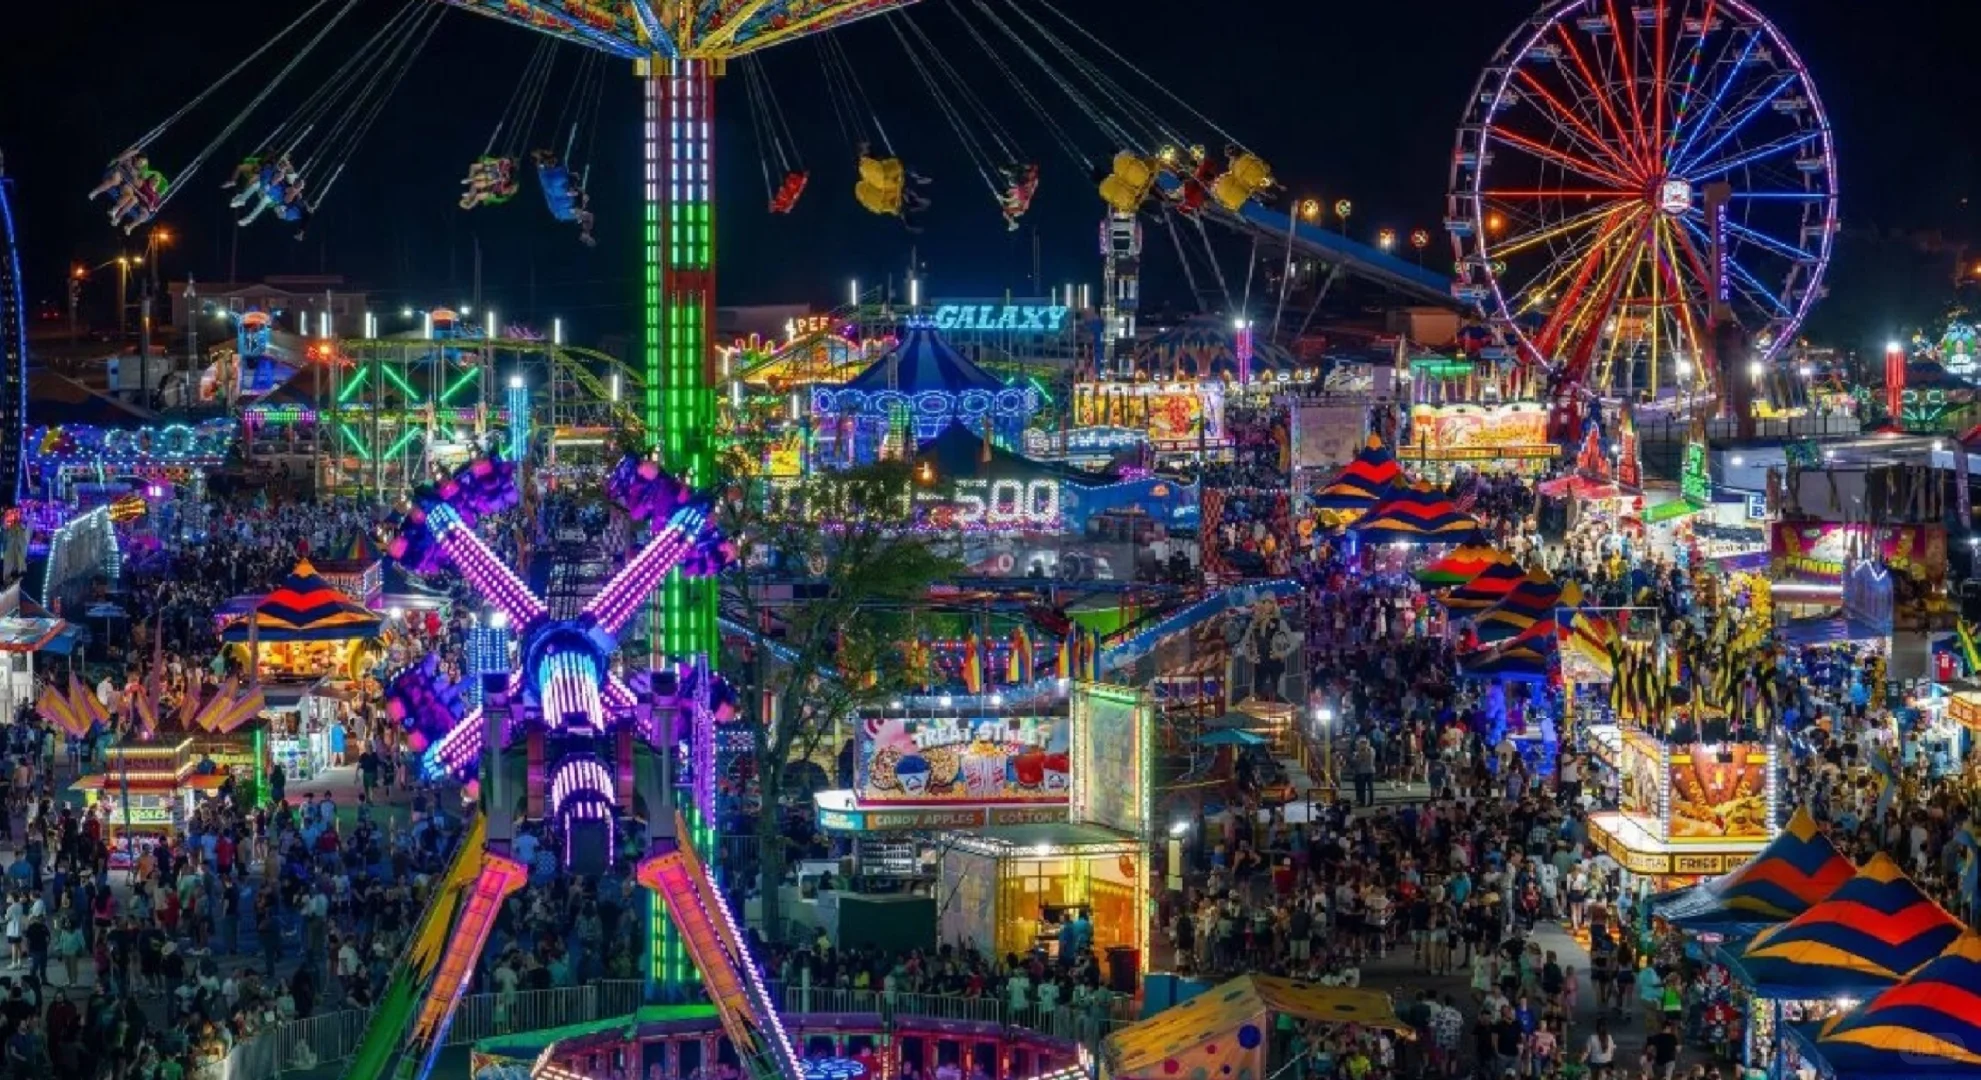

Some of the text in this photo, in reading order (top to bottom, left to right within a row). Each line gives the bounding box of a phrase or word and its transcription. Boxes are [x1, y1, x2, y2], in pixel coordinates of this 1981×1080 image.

[936, 305, 1067, 329] GALAXY
[914, 726, 971, 748] TREAT
[874, 812, 974, 826] CANDY APPLES
[998, 811, 1051, 824] COTTON
